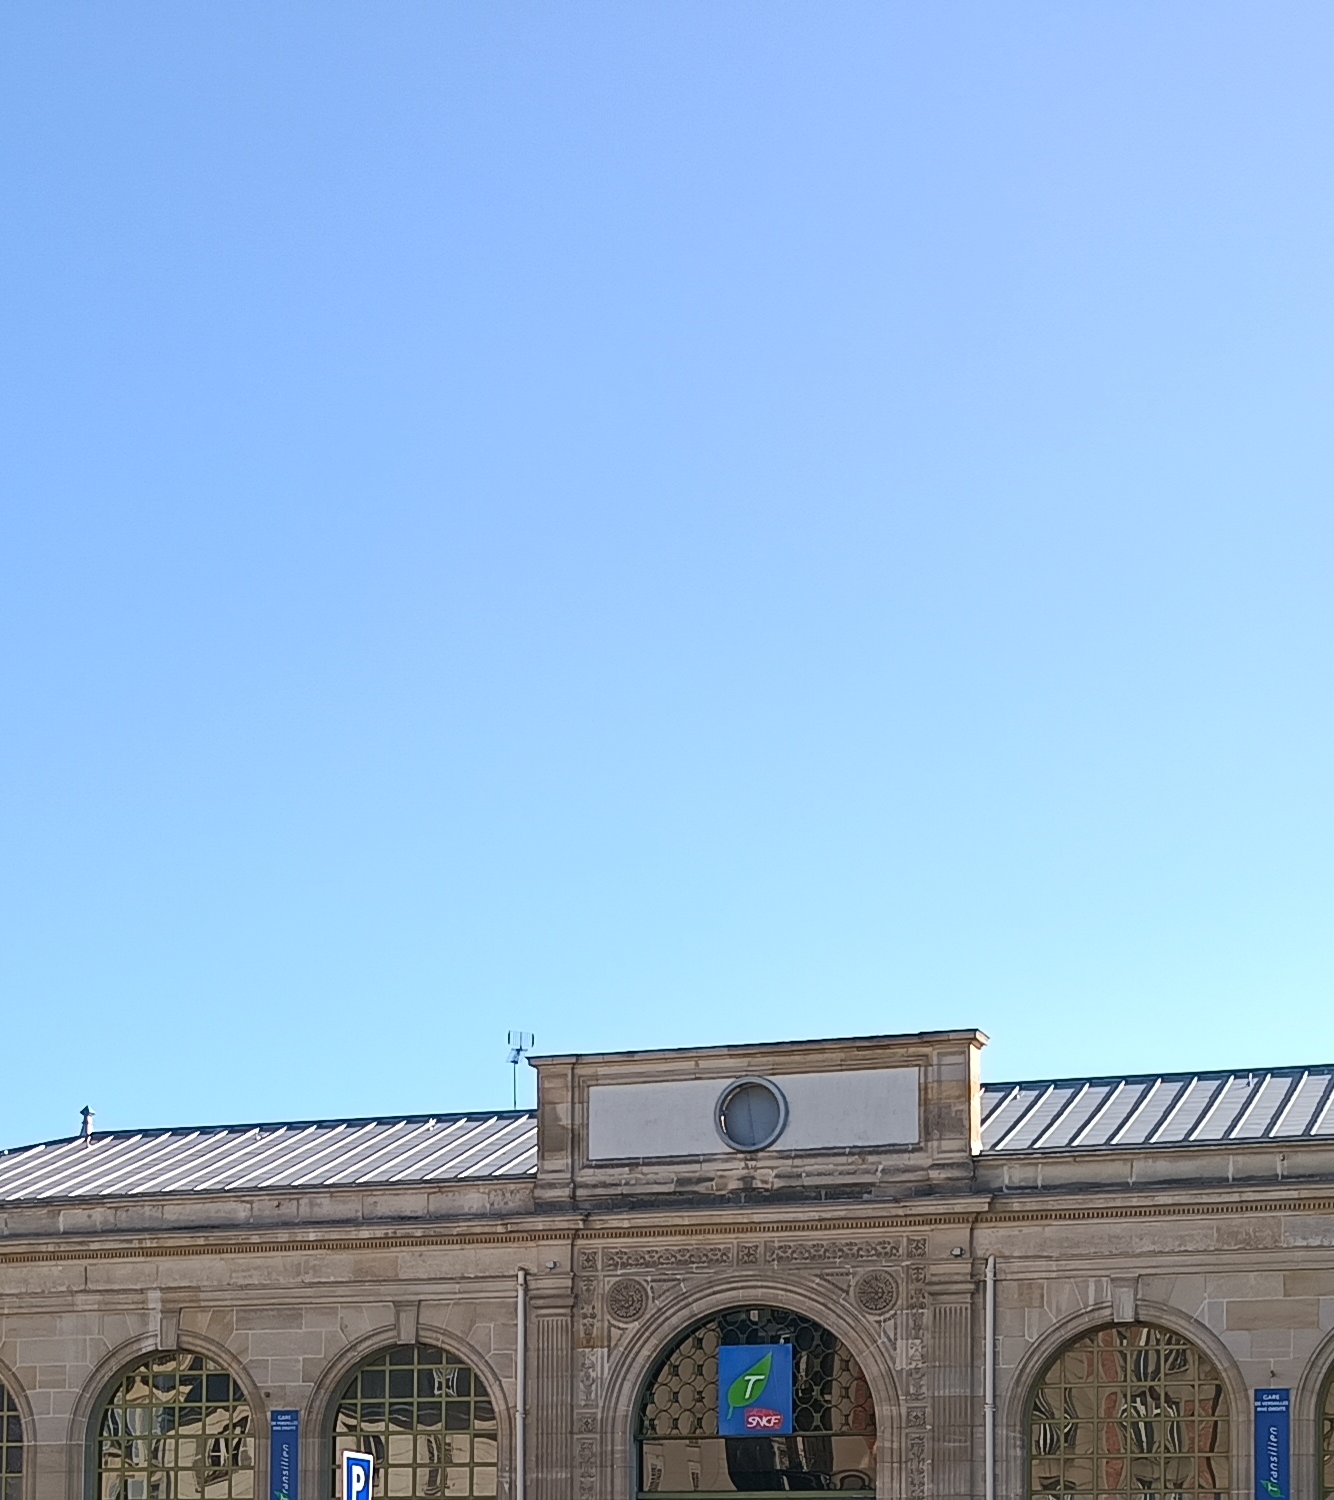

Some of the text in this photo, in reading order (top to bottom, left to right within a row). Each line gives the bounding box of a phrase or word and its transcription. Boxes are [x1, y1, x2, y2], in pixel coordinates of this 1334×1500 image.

[744, 1375, 766, 1399] T
[746, 1415, 781, 1428] SNCF
[1267, 1426, 1279, 1492] Transilien
